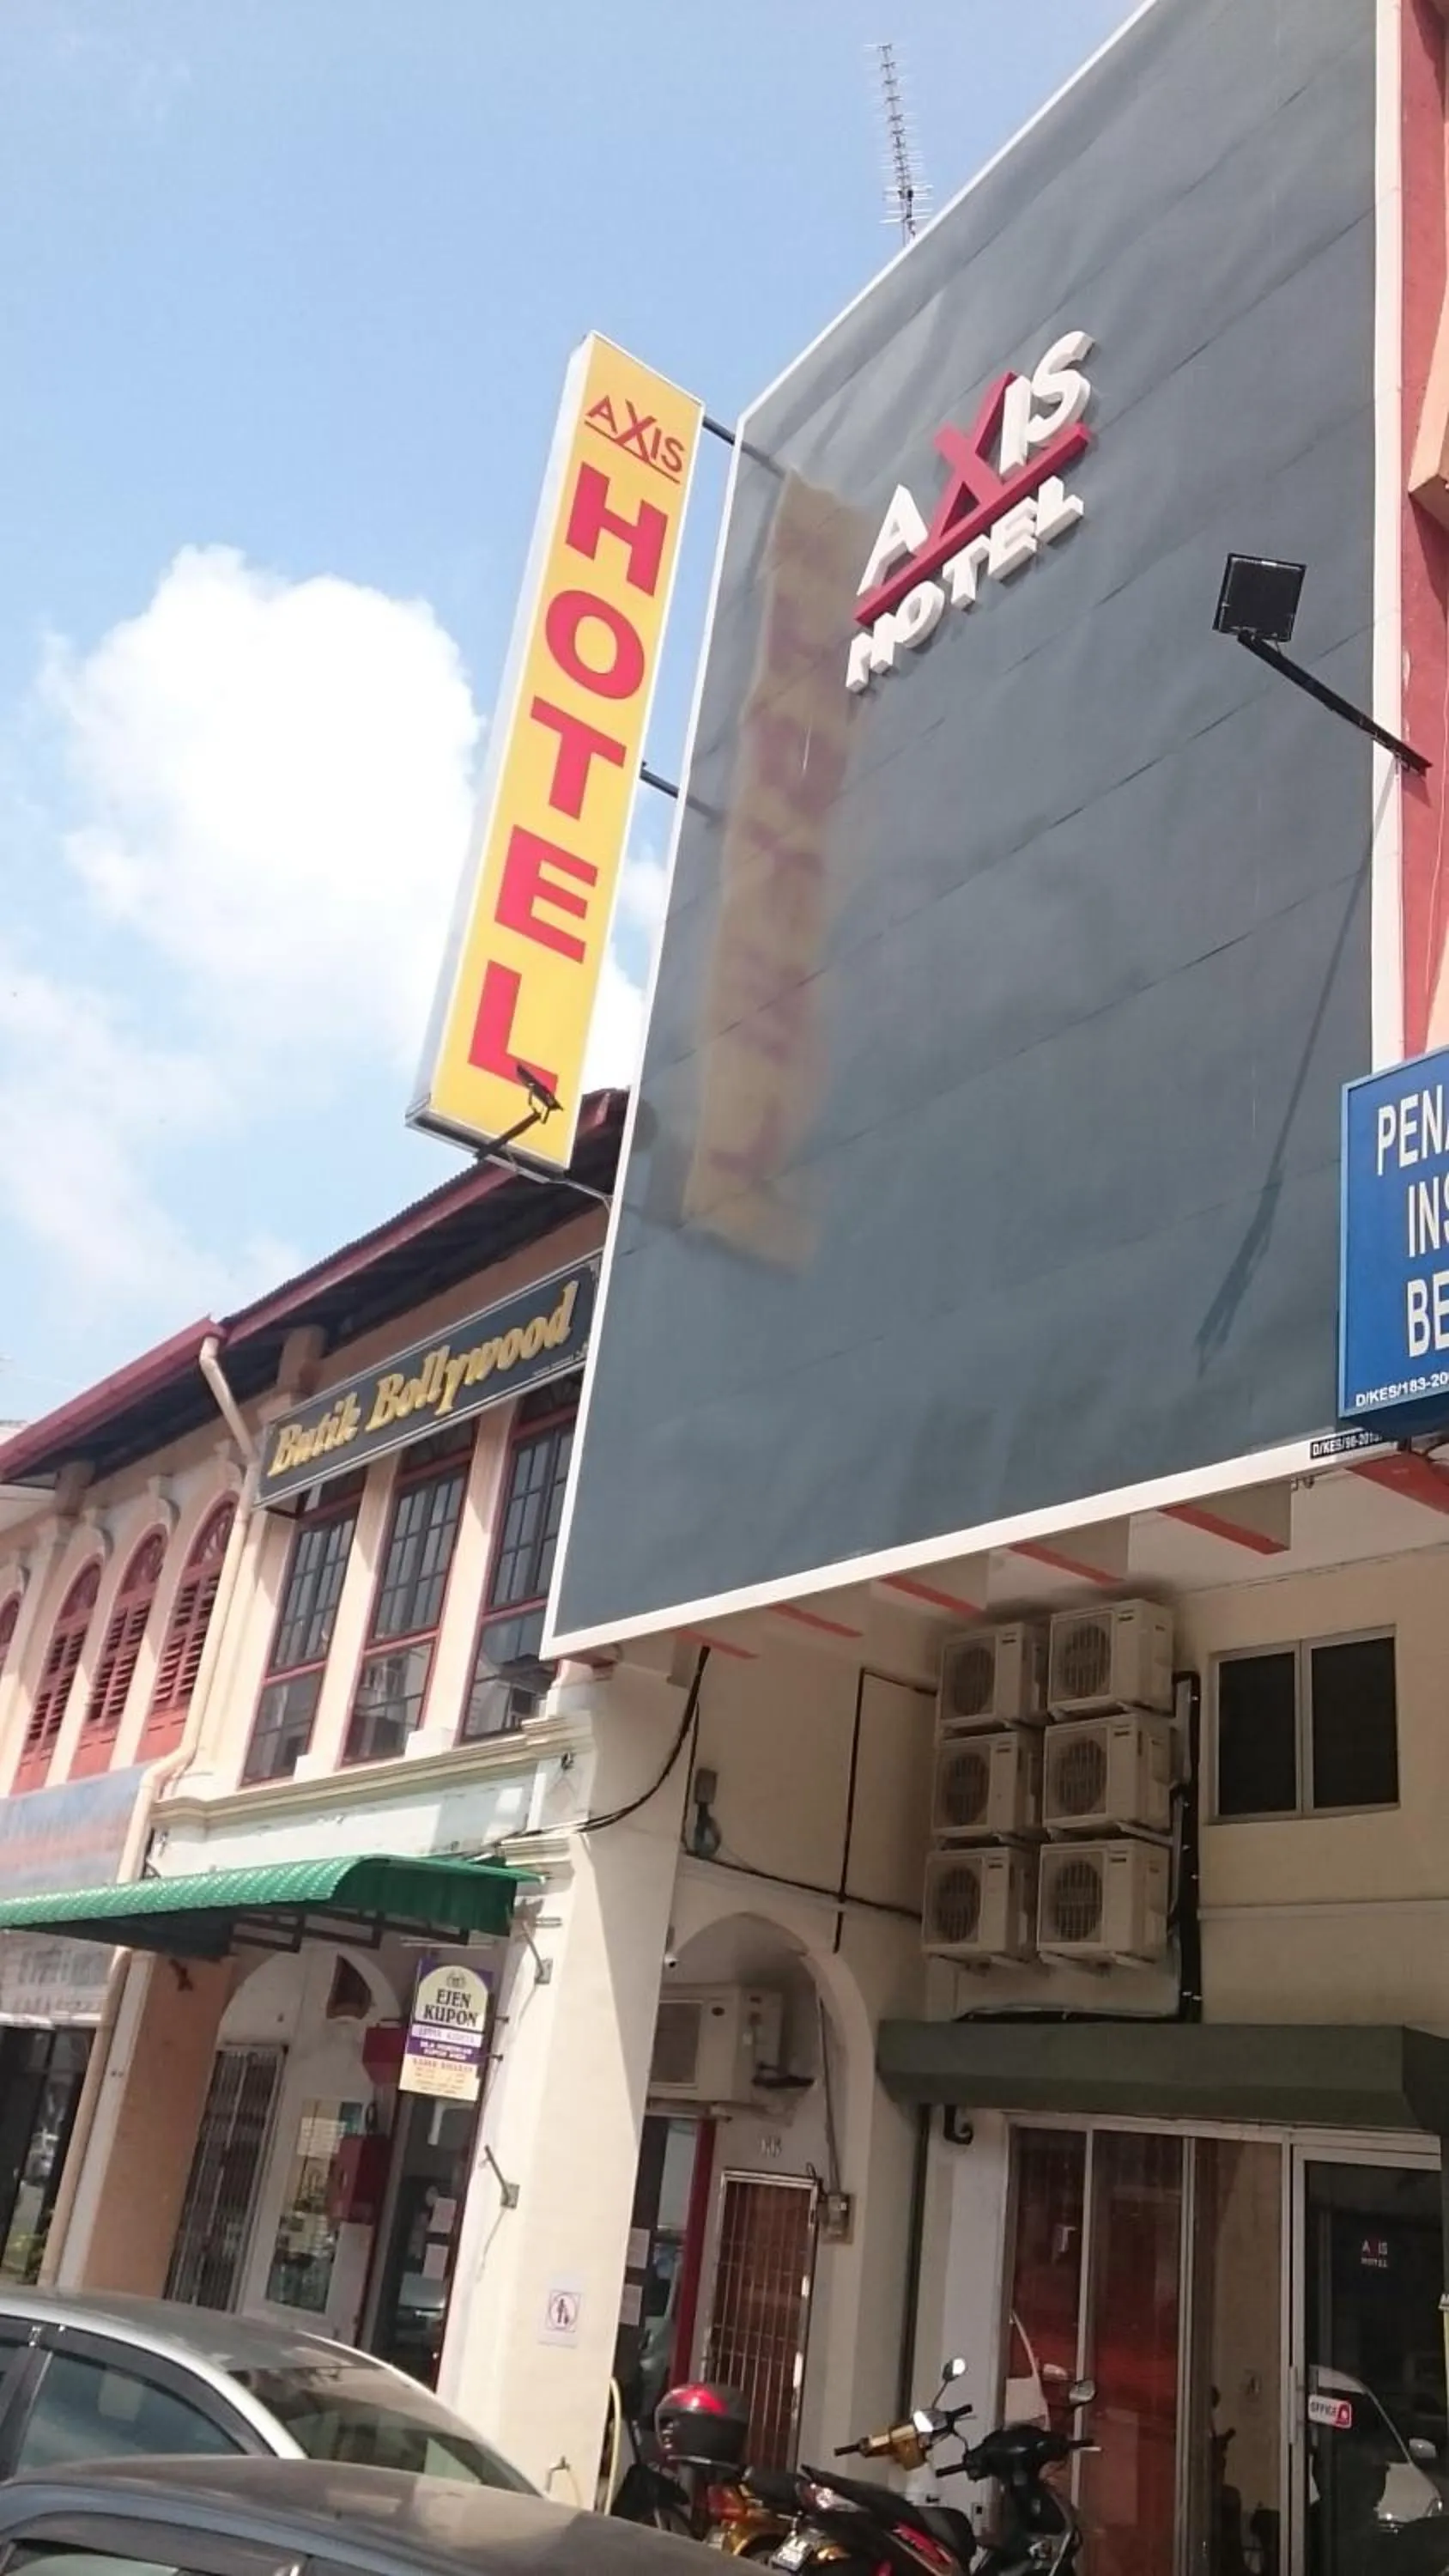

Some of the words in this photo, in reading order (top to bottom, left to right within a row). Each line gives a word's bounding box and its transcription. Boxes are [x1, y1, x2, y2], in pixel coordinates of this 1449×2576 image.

[585, 394, 685, 473] AXIS
[856, 331, 1094, 596] AXIS
[846, 475, 1083, 692] HOTEL
[467, 461, 669, 1097] HOTEL
[1377, 1084, 1449, 1176] PEN
[1408, 1269, 1449, 1357] BE
[267, 1392, 361, 1478] Butik
[365, 1280, 579, 1431] Bollywood
[1355, 1371, 1449, 1407] D/KES/183-20
[424, 2004, 478, 2027] KUPON
[436, 1989, 471, 2008] EJEN
